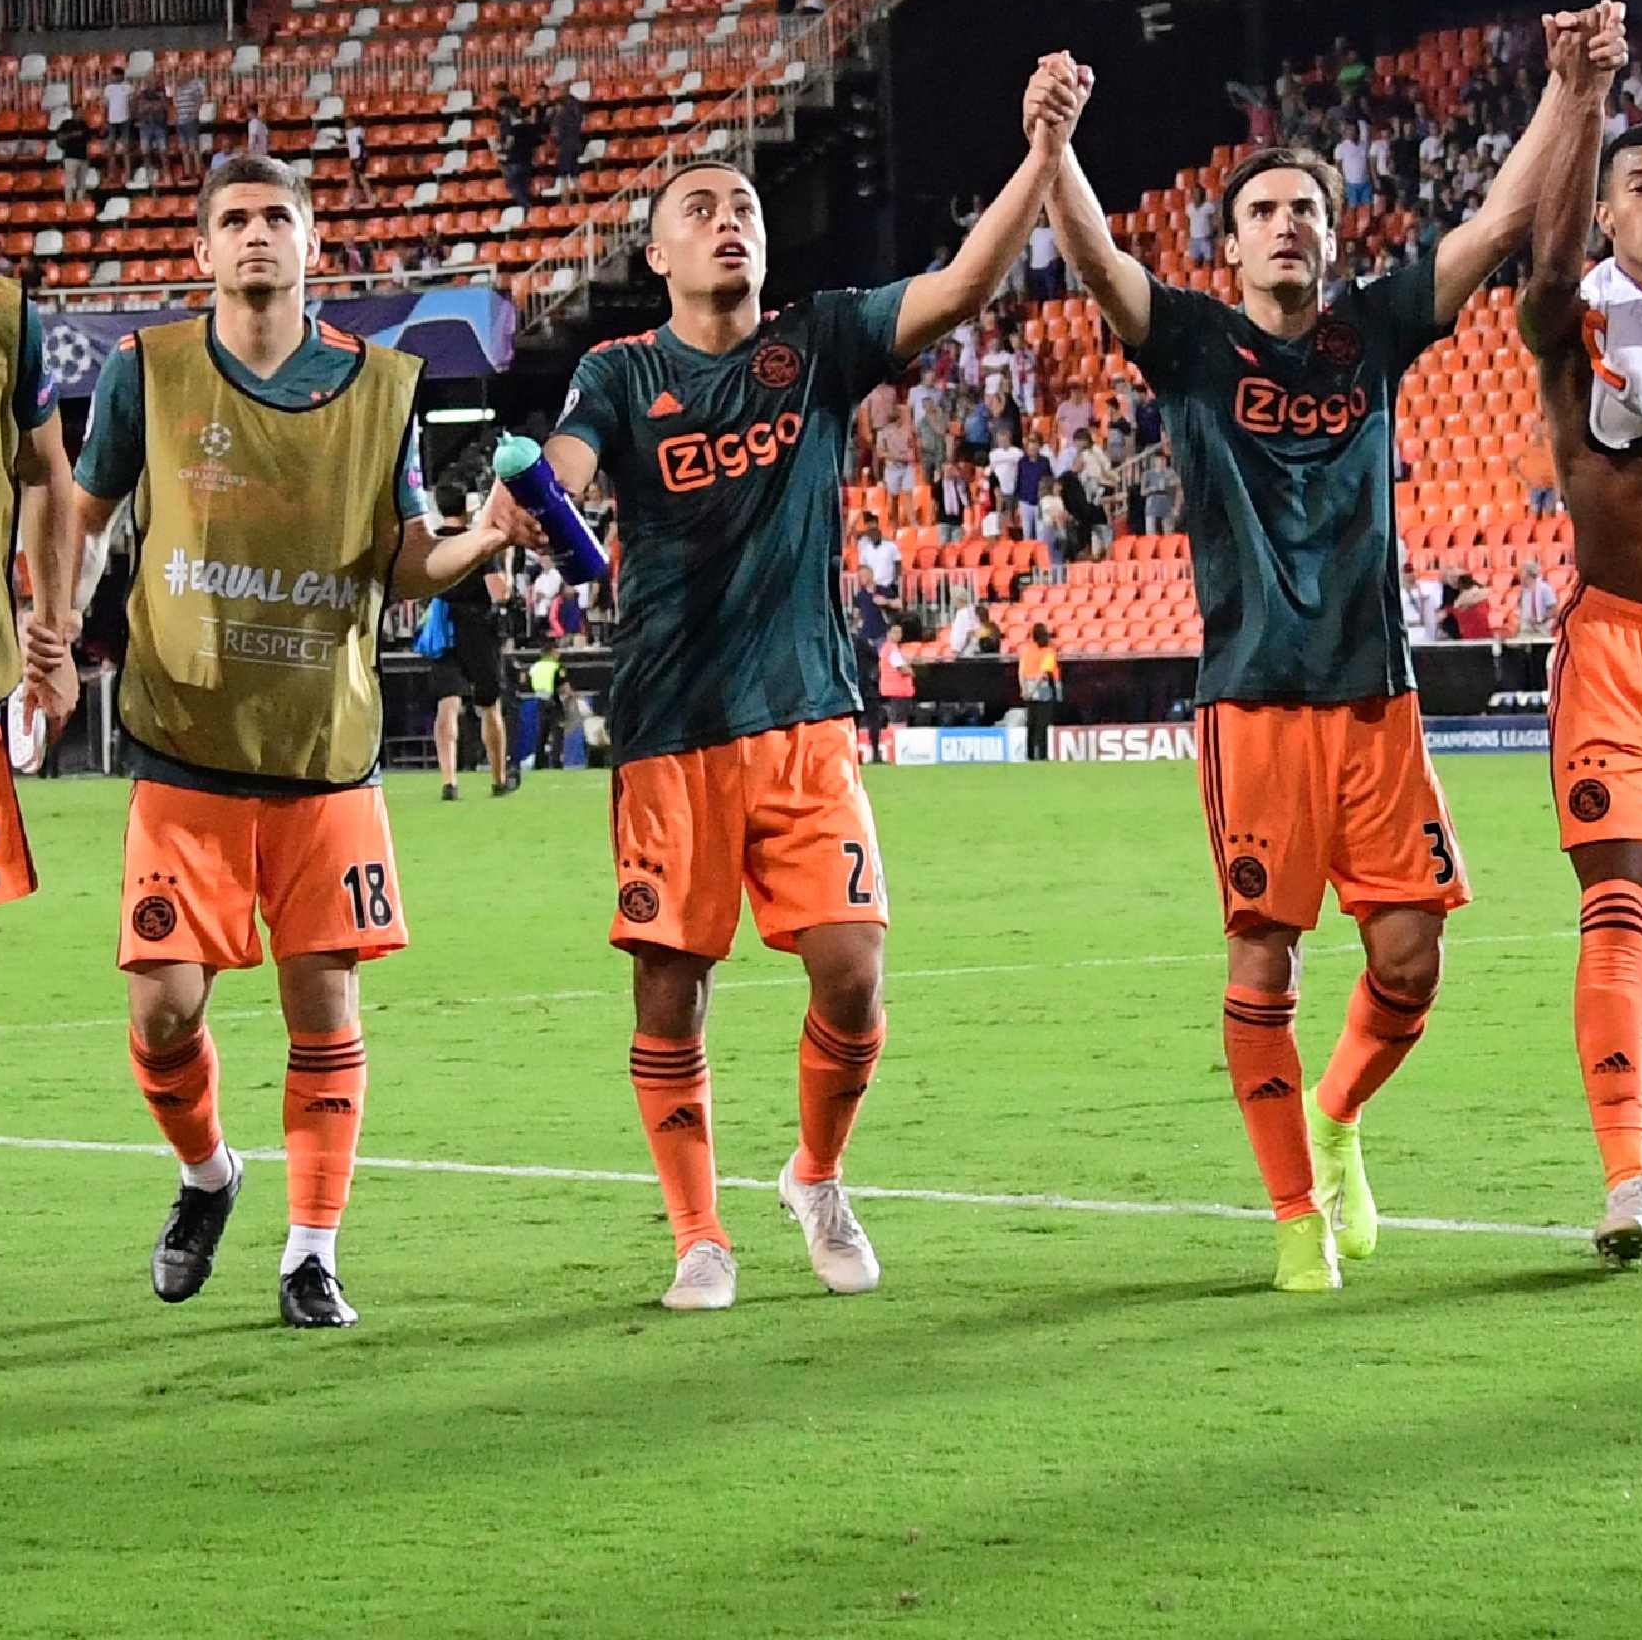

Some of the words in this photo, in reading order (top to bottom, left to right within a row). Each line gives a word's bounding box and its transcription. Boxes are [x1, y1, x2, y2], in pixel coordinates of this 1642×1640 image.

[1236, 377, 1368, 434] Ziggo
[658, 412, 802, 492] Ziggo
[164, 547, 288, 603] #EQUAL
[223, 628, 335, 661] RESPECT
[1059, 728, 1198, 761] NISSAN
[1422, 820, 1455, 887] 3
[341, 861, 394, 932] 18
